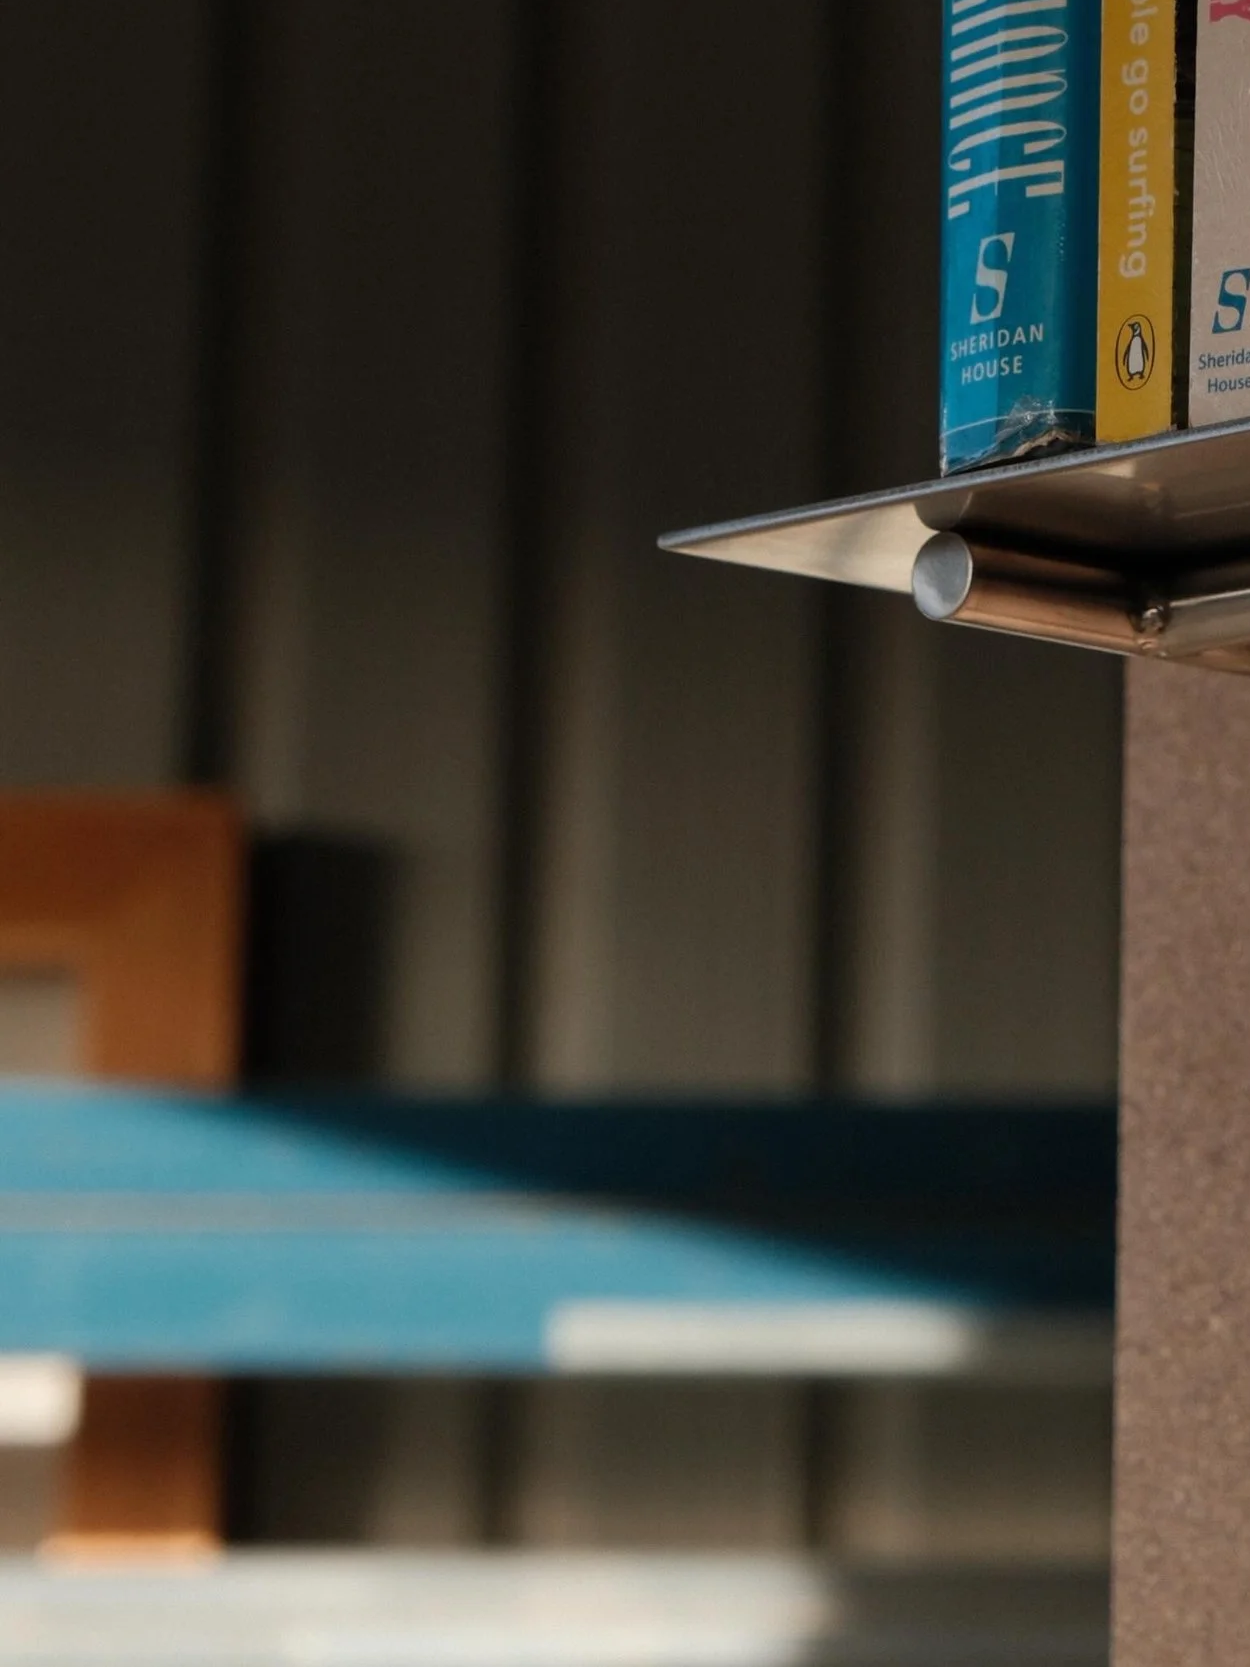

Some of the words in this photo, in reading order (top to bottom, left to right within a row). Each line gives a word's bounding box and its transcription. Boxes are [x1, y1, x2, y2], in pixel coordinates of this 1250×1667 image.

[1119, 58, 1149, 117] go
[1117, 127, 1156, 278] surfing
[950, 322, 1044, 362] SHERIDAN
[961, 355, 1023, 385] HOUSE
